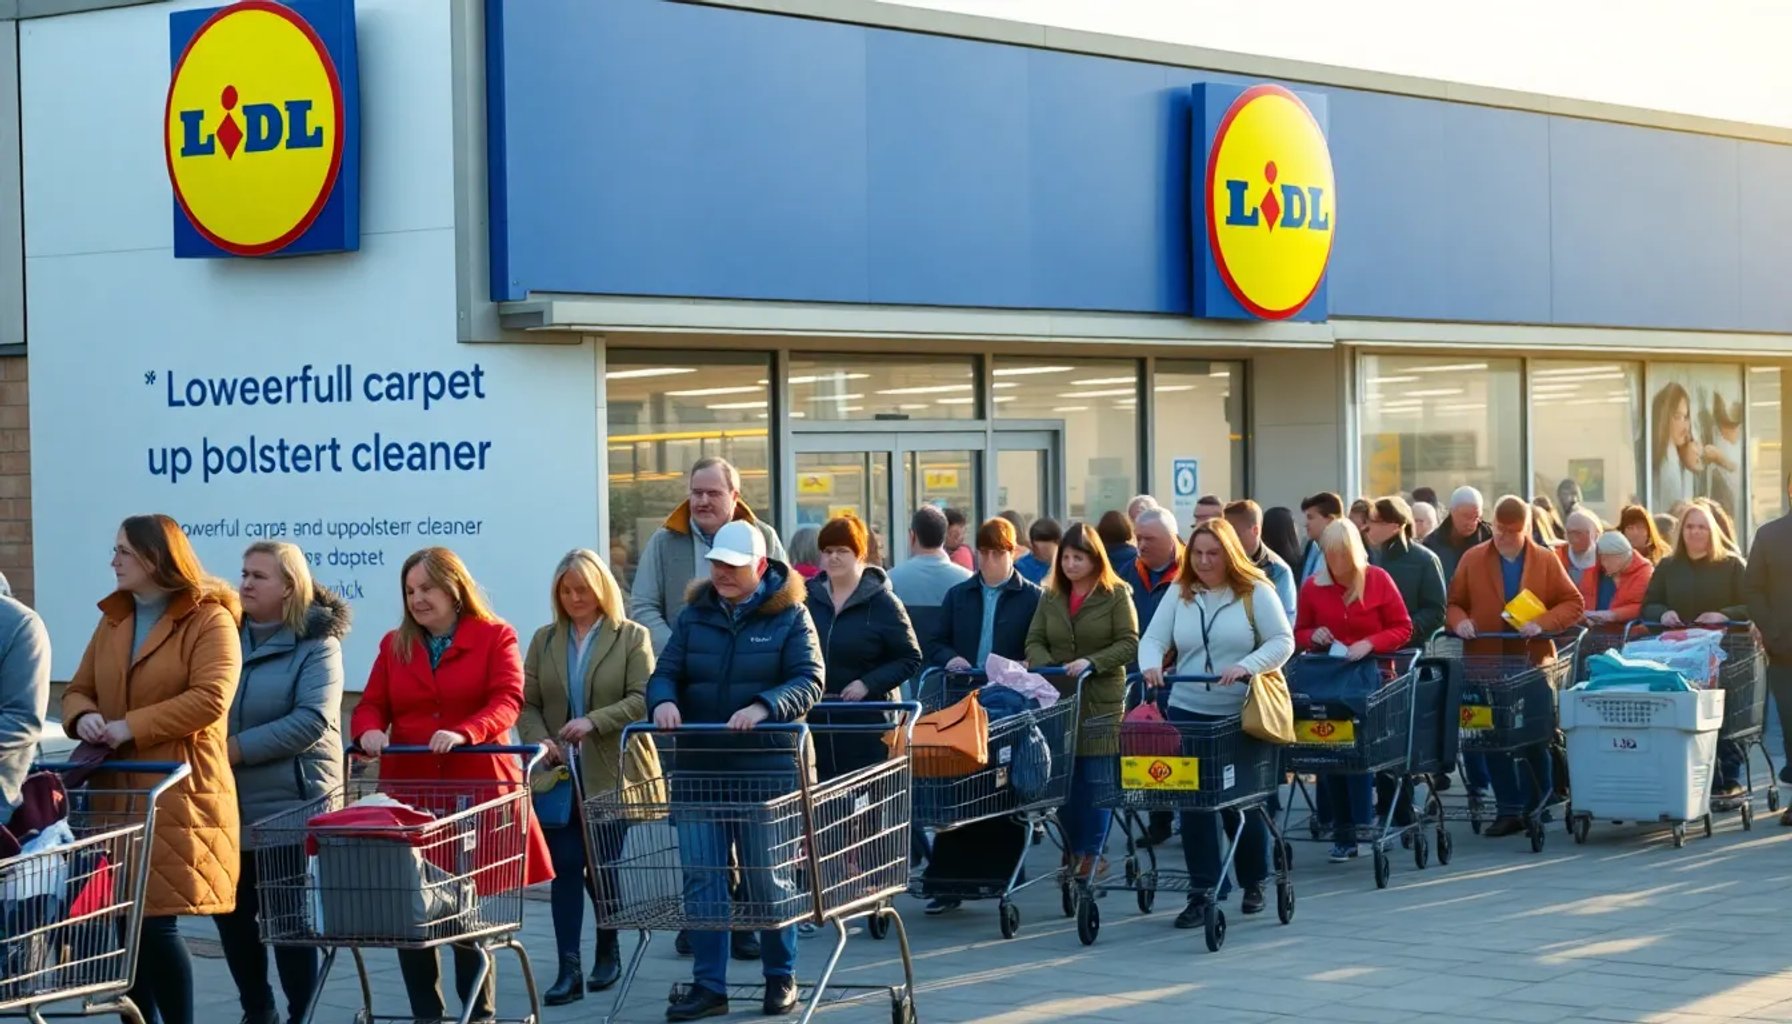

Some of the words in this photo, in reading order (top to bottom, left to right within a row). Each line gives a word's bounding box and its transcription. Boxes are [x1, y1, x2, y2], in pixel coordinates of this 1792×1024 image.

[167, 364, 352, 407] Loweerfull
[363, 363, 486, 410] carpet
[148, 446, 192, 483] up
[352, 432, 492, 473] cleaner
[293, 518, 323, 536] and
[417, 516, 482, 535] cleaner
